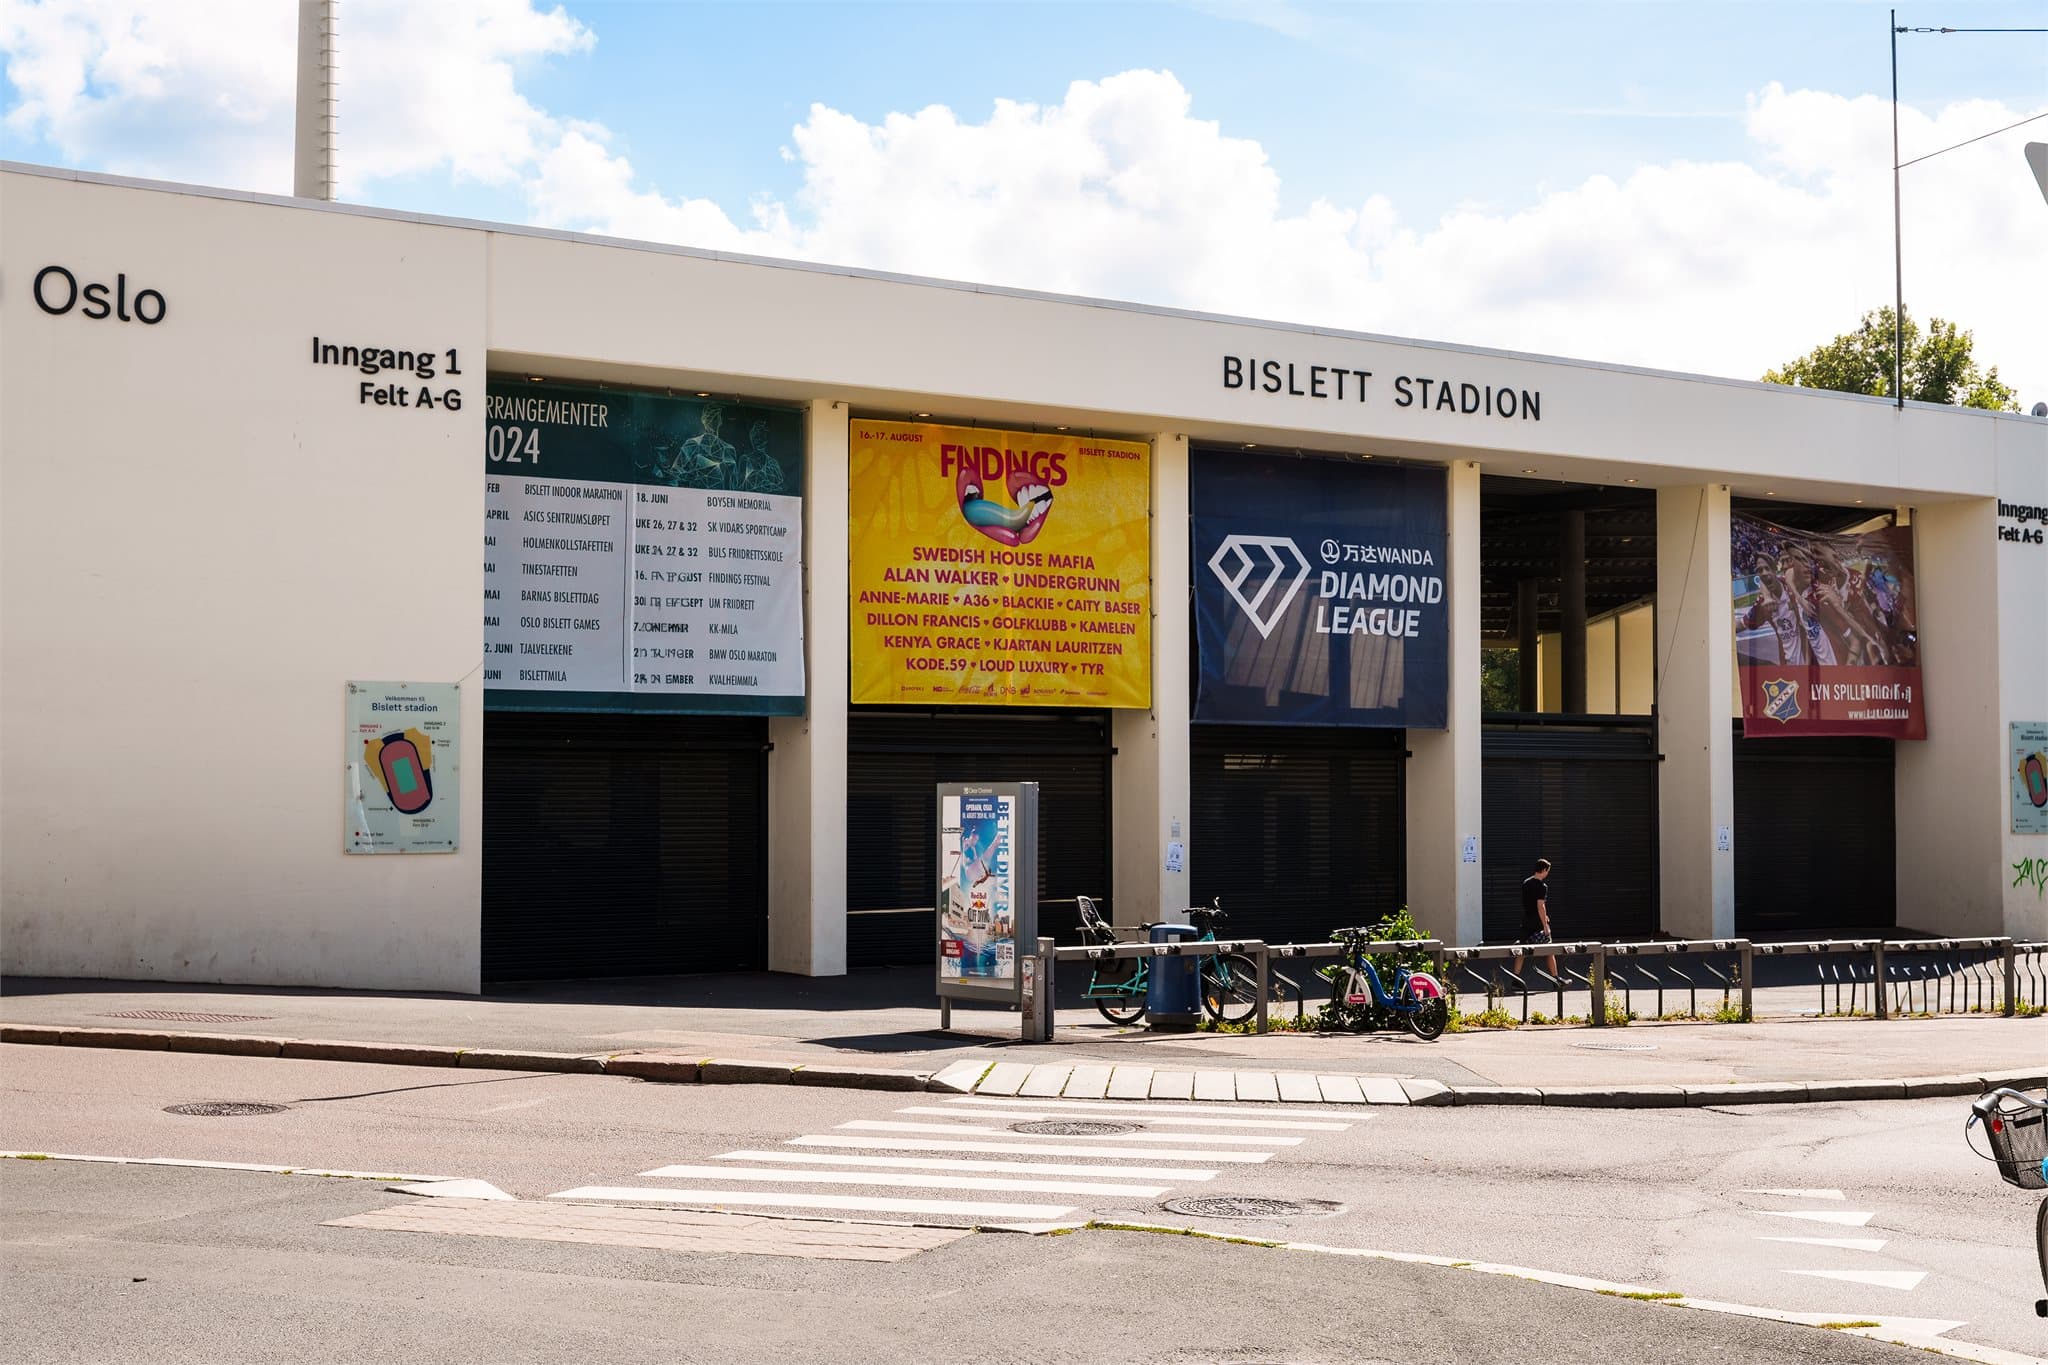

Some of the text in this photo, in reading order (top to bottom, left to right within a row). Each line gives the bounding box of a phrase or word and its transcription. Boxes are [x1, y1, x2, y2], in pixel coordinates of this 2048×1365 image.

[33, 265, 167, 325] Oslo
[312, 336, 462, 379] Inngang 1
[360, 382, 462, 411] Felt A-G
[1223, 355, 1541, 421] BISLETT STADION
[890, 433, 923, 442] AUGUST
[1079, 447, 1141, 460] BISLETT STADION
[941, 443, 1067, 487] FINDINGS
[487, 483, 623, 501] FEB BISLETT INDOOR MARATHON
[636, 493, 772, 511] 18. JUNI BOYSEN MEMORIAL
[486, 510, 610, 526] APRIL ASICS SENTRUMSLØPET
[1998, 499, 2048, 525] Inngang
[636, 518, 650, 528] UKE
[653, 520, 664, 531] 26,
[668, 520, 677, 530] 27
[679, 522, 685, 531] &
[687, 522, 697, 531] 32
[708, 522, 717, 532] SK
[719, 522, 744, 534] VIDARS
[1998, 526, 2043, 544] Felt A-G
[523, 537, 613, 552] HOLMENKOLLSTAFETTEN
[635, 544, 650, 554] UKE
[678, 547, 685, 556] &
[687, 547, 698, 557] 32
[708, 547, 726, 558] BULS
[1343, 544, 1377, 563] 万达
[912, 547, 1095, 570] SWEDISH HOUSE MAFIA
[1377, 547, 1434, 566] WANDA
[522, 563, 578, 576] TINESTAFETTEN
[635, 570, 647, 580] 16.
[709, 572, 742, 584] FINDINGS
[743, 574, 771, 586] FESTIVAL
[883, 568, 1120, 592] ALAN WALKER UNDERGRUNN
[1319, 570, 1443, 604] DIAMOND
[484, 590, 600, 604] MAI BARNAS BISLETTDAG
[709, 598, 721, 608] UM
[859, 591, 1141, 615] ANNE-MARIE A36 BLACKIE CAITY BASER
[484, 616, 600, 630] MAI OSLO BISLETT GAMES
[709, 623, 738, 635] KK-MILA
[867, 612, 1136, 635] DILLON FRANCIS GOLFKLUBB KAMELEN
[1315, 605, 1420, 637] LEAGUE
[494, 644, 513, 654] JUNI
[520, 643, 573, 656] TJALVELEKENE
[884, 635, 1123, 656] KENYA GRACE KJARTAN LAURITZEN
[709, 648, 727, 660] BMW
[729, 649, 746, 661] OSLO
[747, 650, 777, 662] MARATON
[483, 669, 567, 682] JUNI BISLETTMILA
[906, 657, 1104, 676] KODE.59 LOUD LUXURY TYR
[1811, 684, 1831, 700] LYN
[371, 703, 438, 712] Bislett stadion
